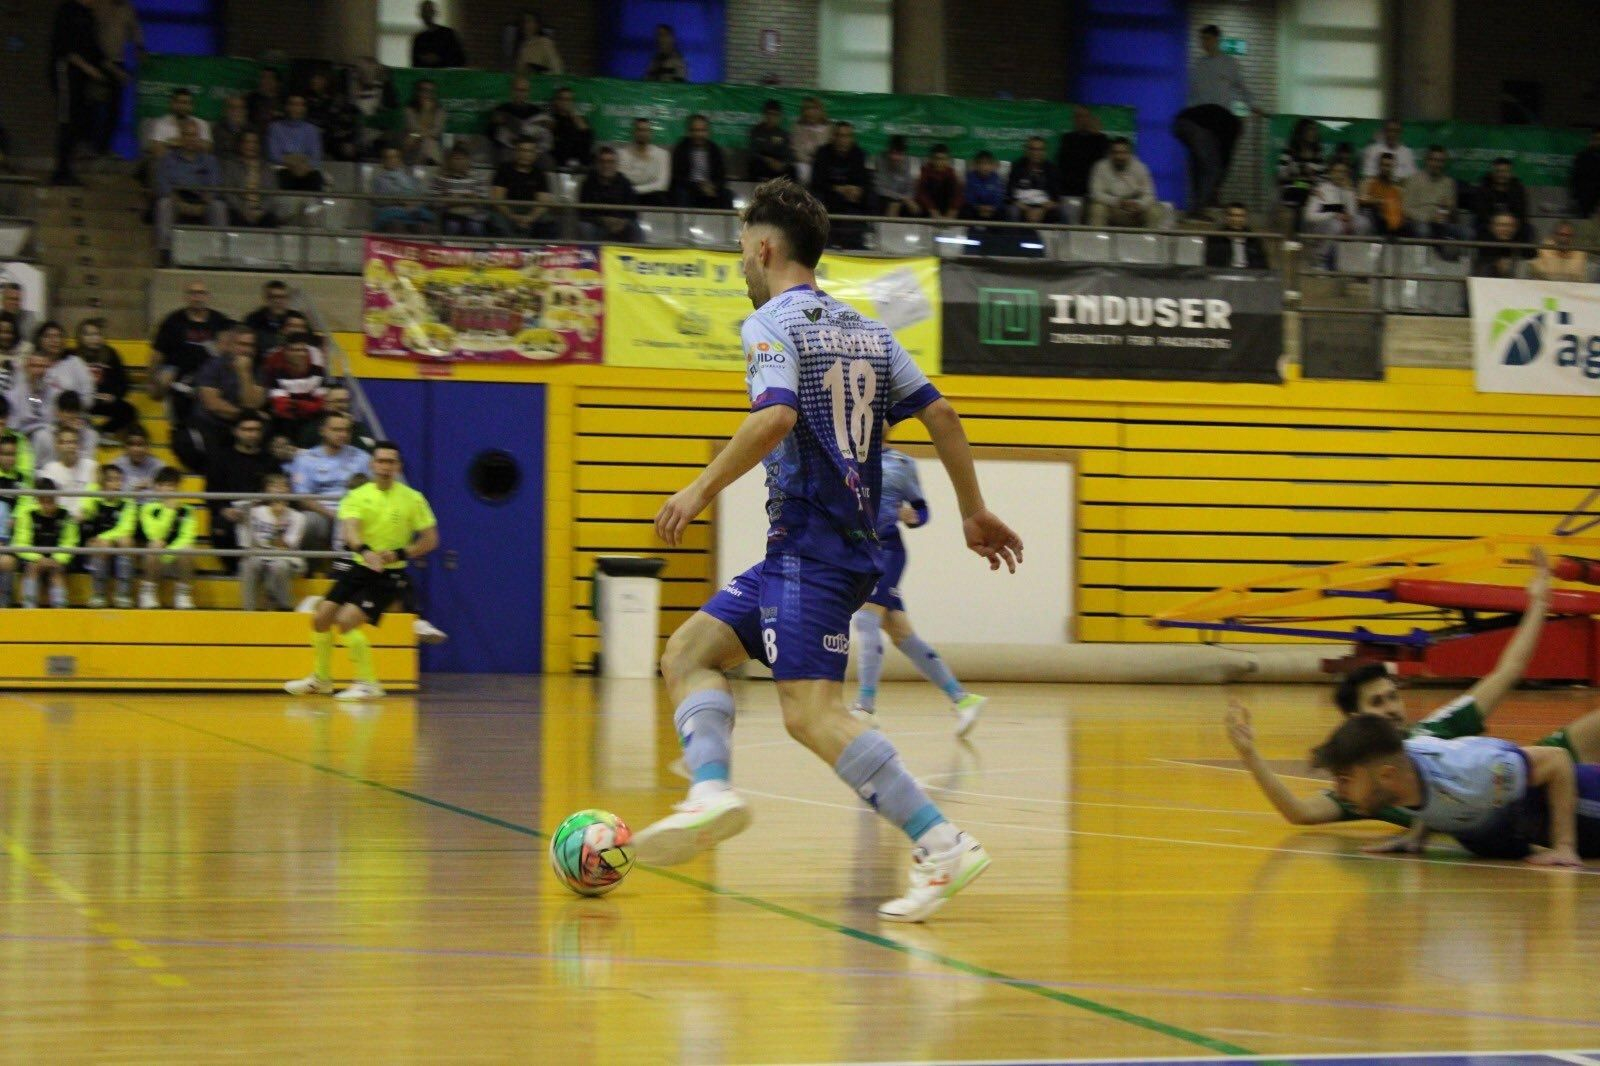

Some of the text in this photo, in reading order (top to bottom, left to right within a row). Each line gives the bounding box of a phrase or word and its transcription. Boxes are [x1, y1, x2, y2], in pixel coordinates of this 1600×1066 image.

[618, 255, 707, 278] Teruel
[1048, 294, 1232, 330] INDUSER
[822, 357, 877, 464] 18
[763, 628, 778, 664] 8
